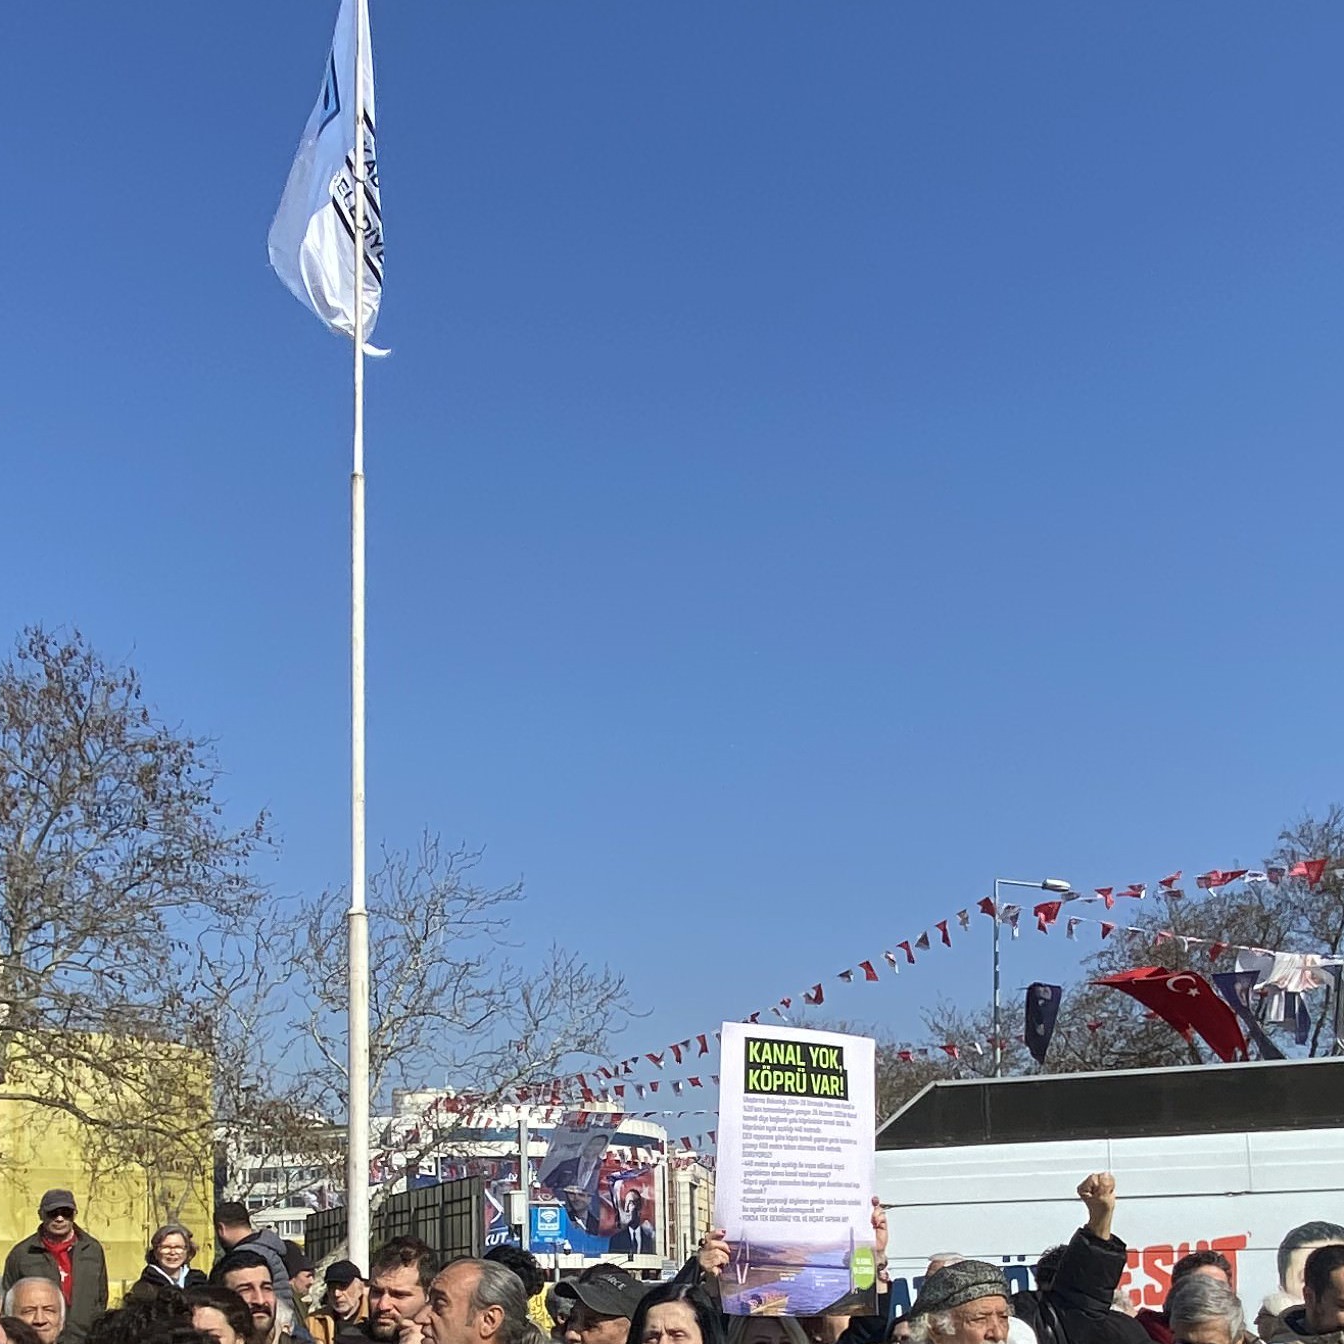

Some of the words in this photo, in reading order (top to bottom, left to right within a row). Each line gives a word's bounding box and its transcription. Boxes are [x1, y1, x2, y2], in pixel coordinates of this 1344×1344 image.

[749, 1041, 805, 1067] KANAL
[809, 1047, 843, 1071] YOK,
[748, 1065, 806, 1093] KÖPRÜ
[810, 1074, 844, 1096] VAR!
